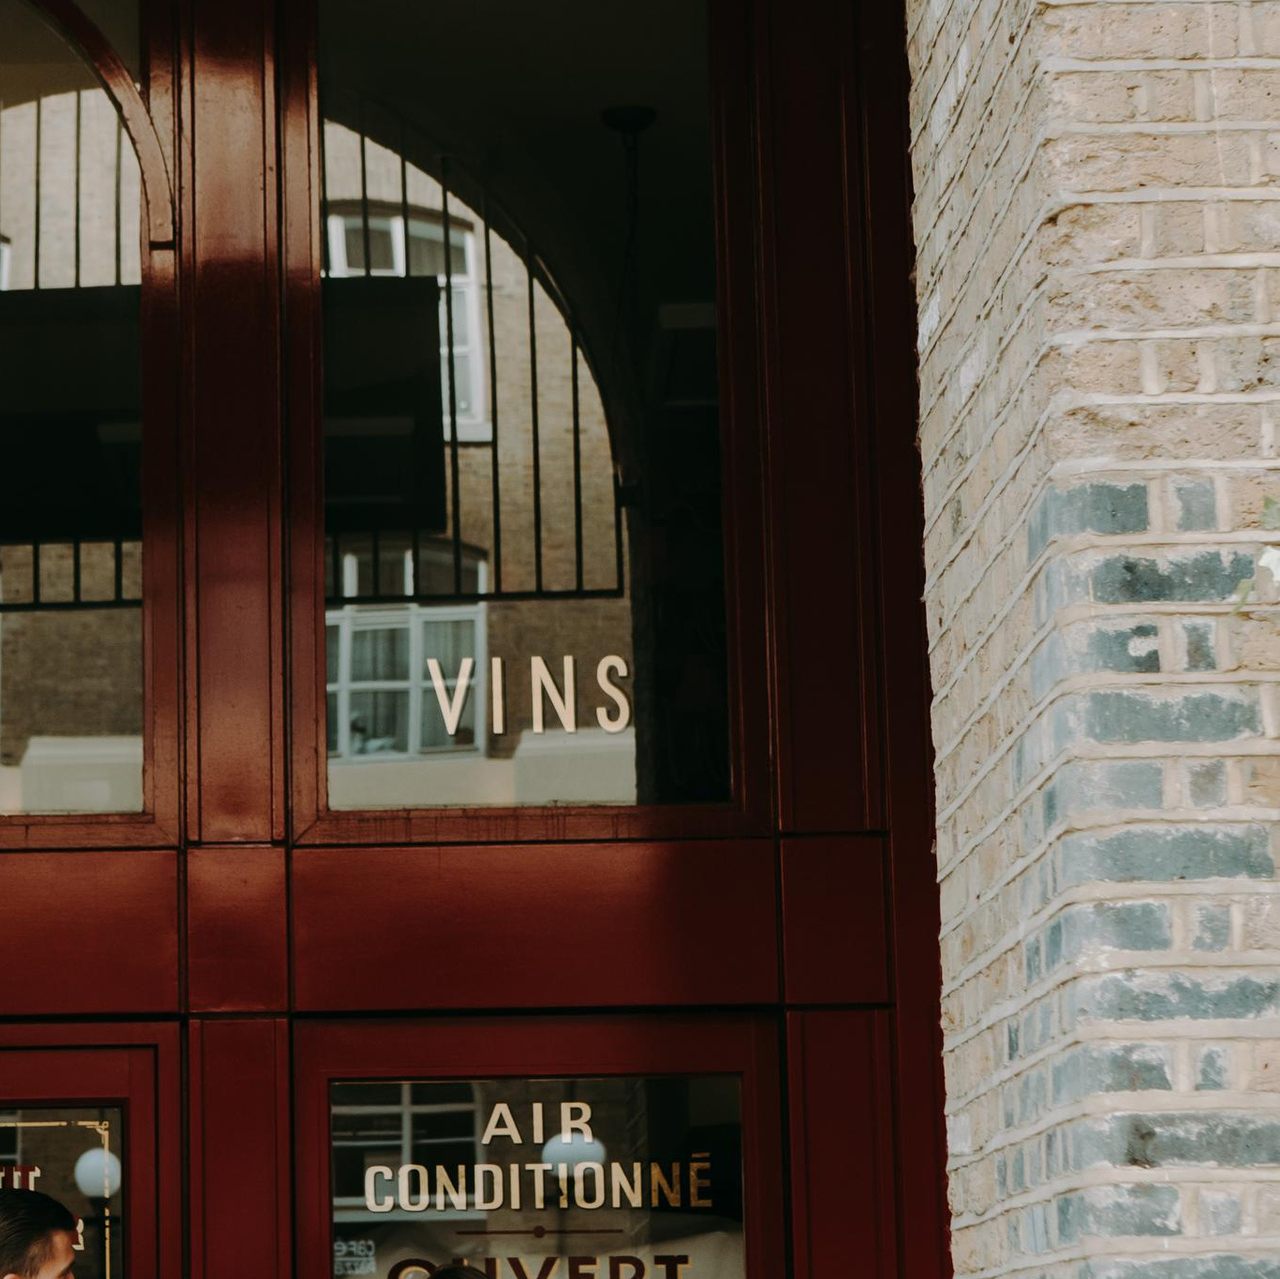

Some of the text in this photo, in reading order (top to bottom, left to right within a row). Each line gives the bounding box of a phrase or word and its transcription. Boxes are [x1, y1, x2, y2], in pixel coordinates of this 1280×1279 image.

[426, 654, 631, 736] VINS
[481, 1100, 594, 1146] AIR
[364, 1151, 713, 1212] CONDITIONNÉ
